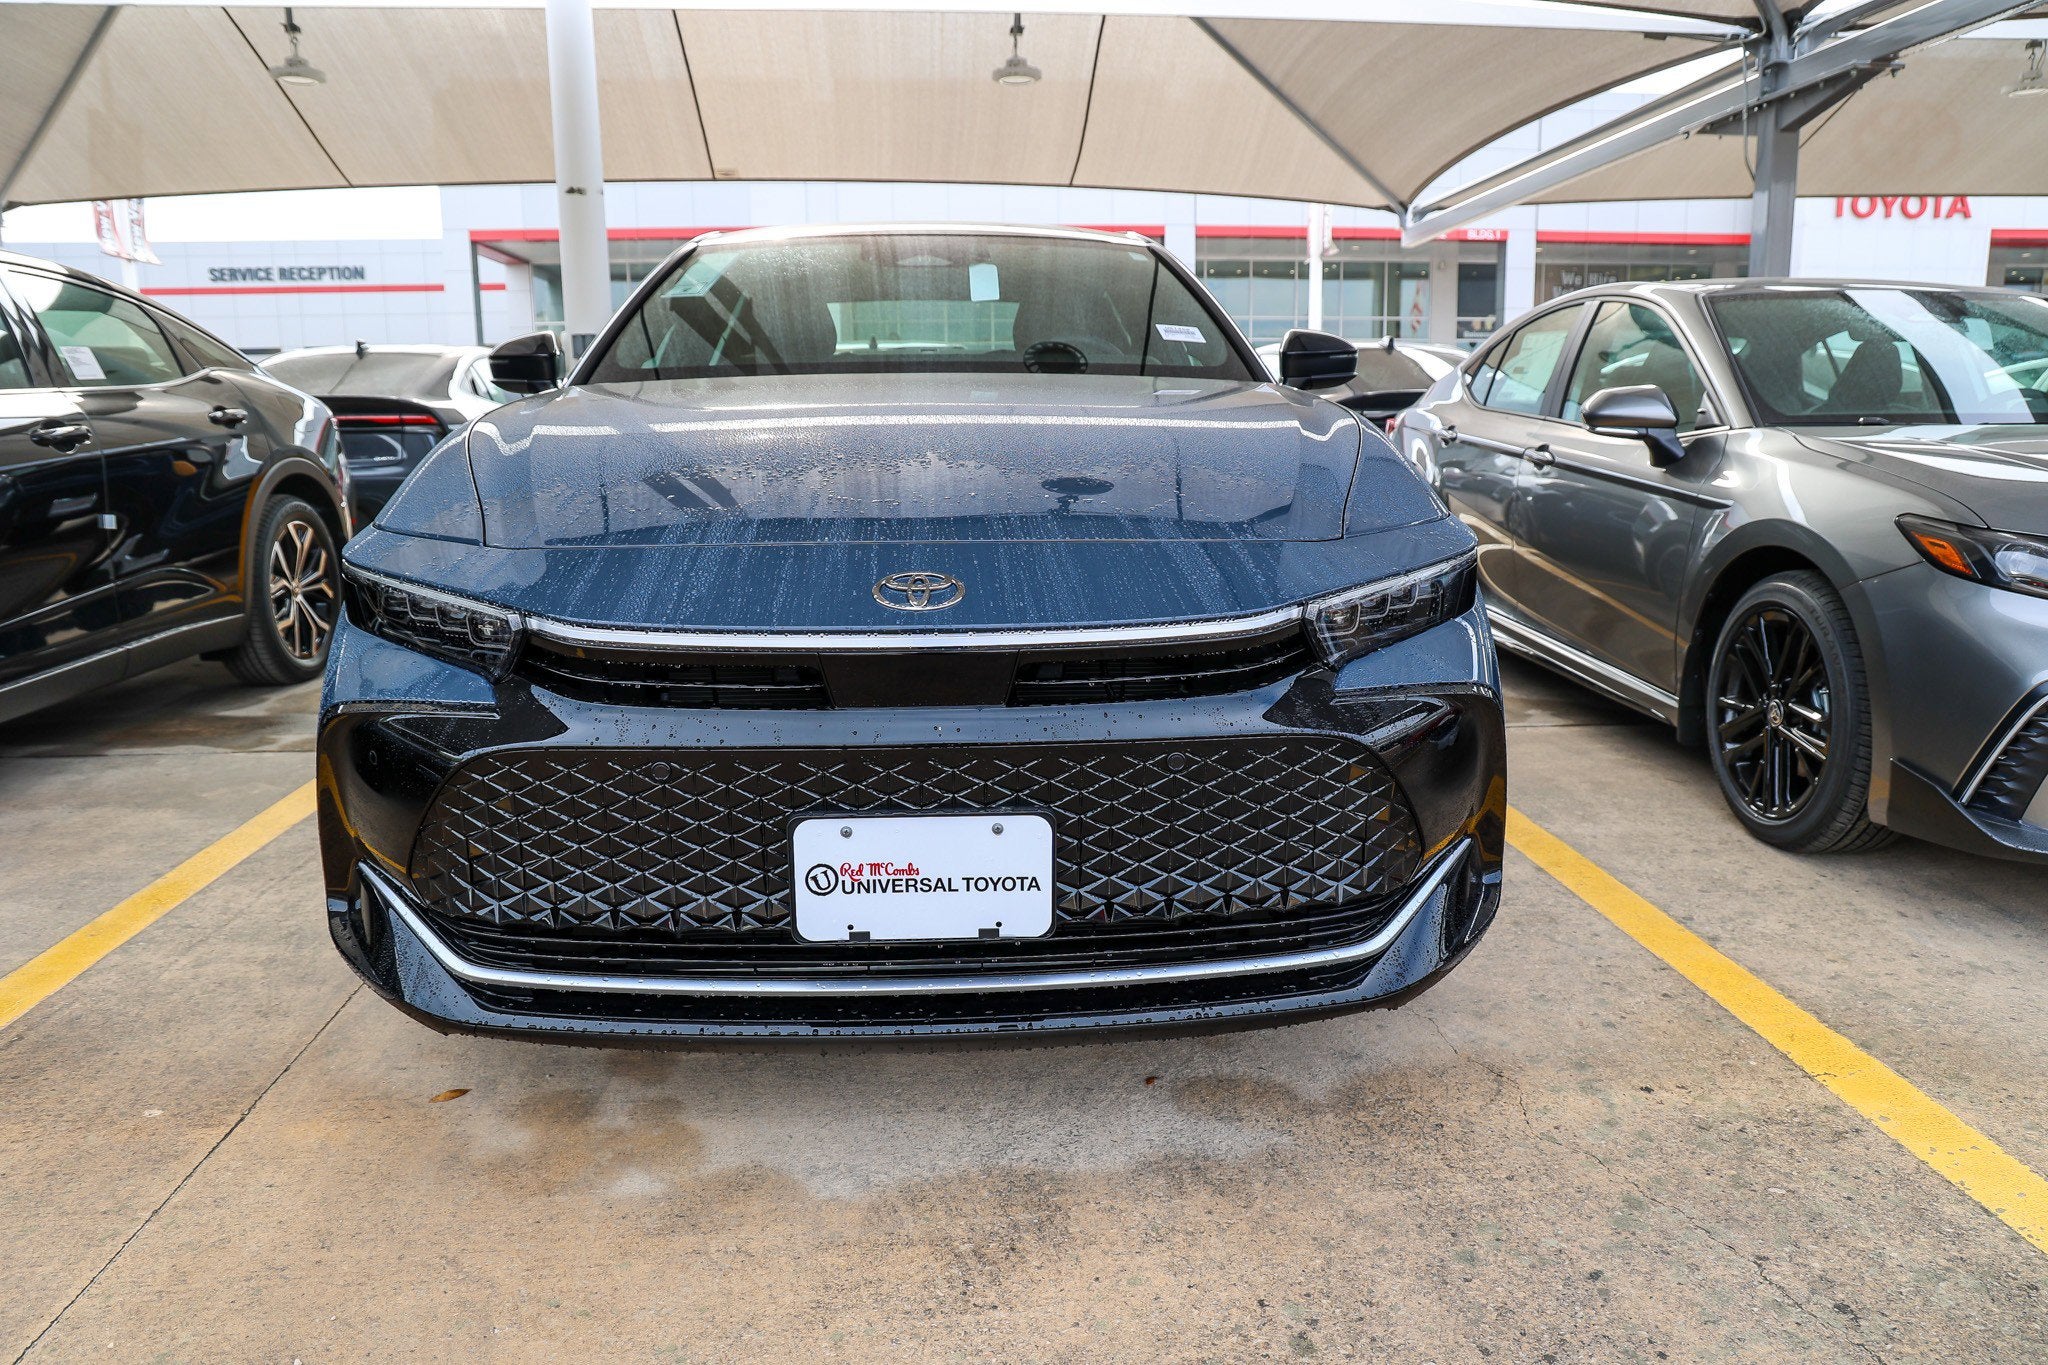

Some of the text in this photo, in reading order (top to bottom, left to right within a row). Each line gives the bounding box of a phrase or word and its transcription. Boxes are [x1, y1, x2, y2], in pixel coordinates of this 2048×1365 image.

[1835, 195, 1972, 219] TOYOTA
[209, 265, 365, 282] SERVICE RECEPTION
[840, 862, 920, 882] Red McCombs
[841, 876, 1041, 895] UNIVERSAL TOYOTA
